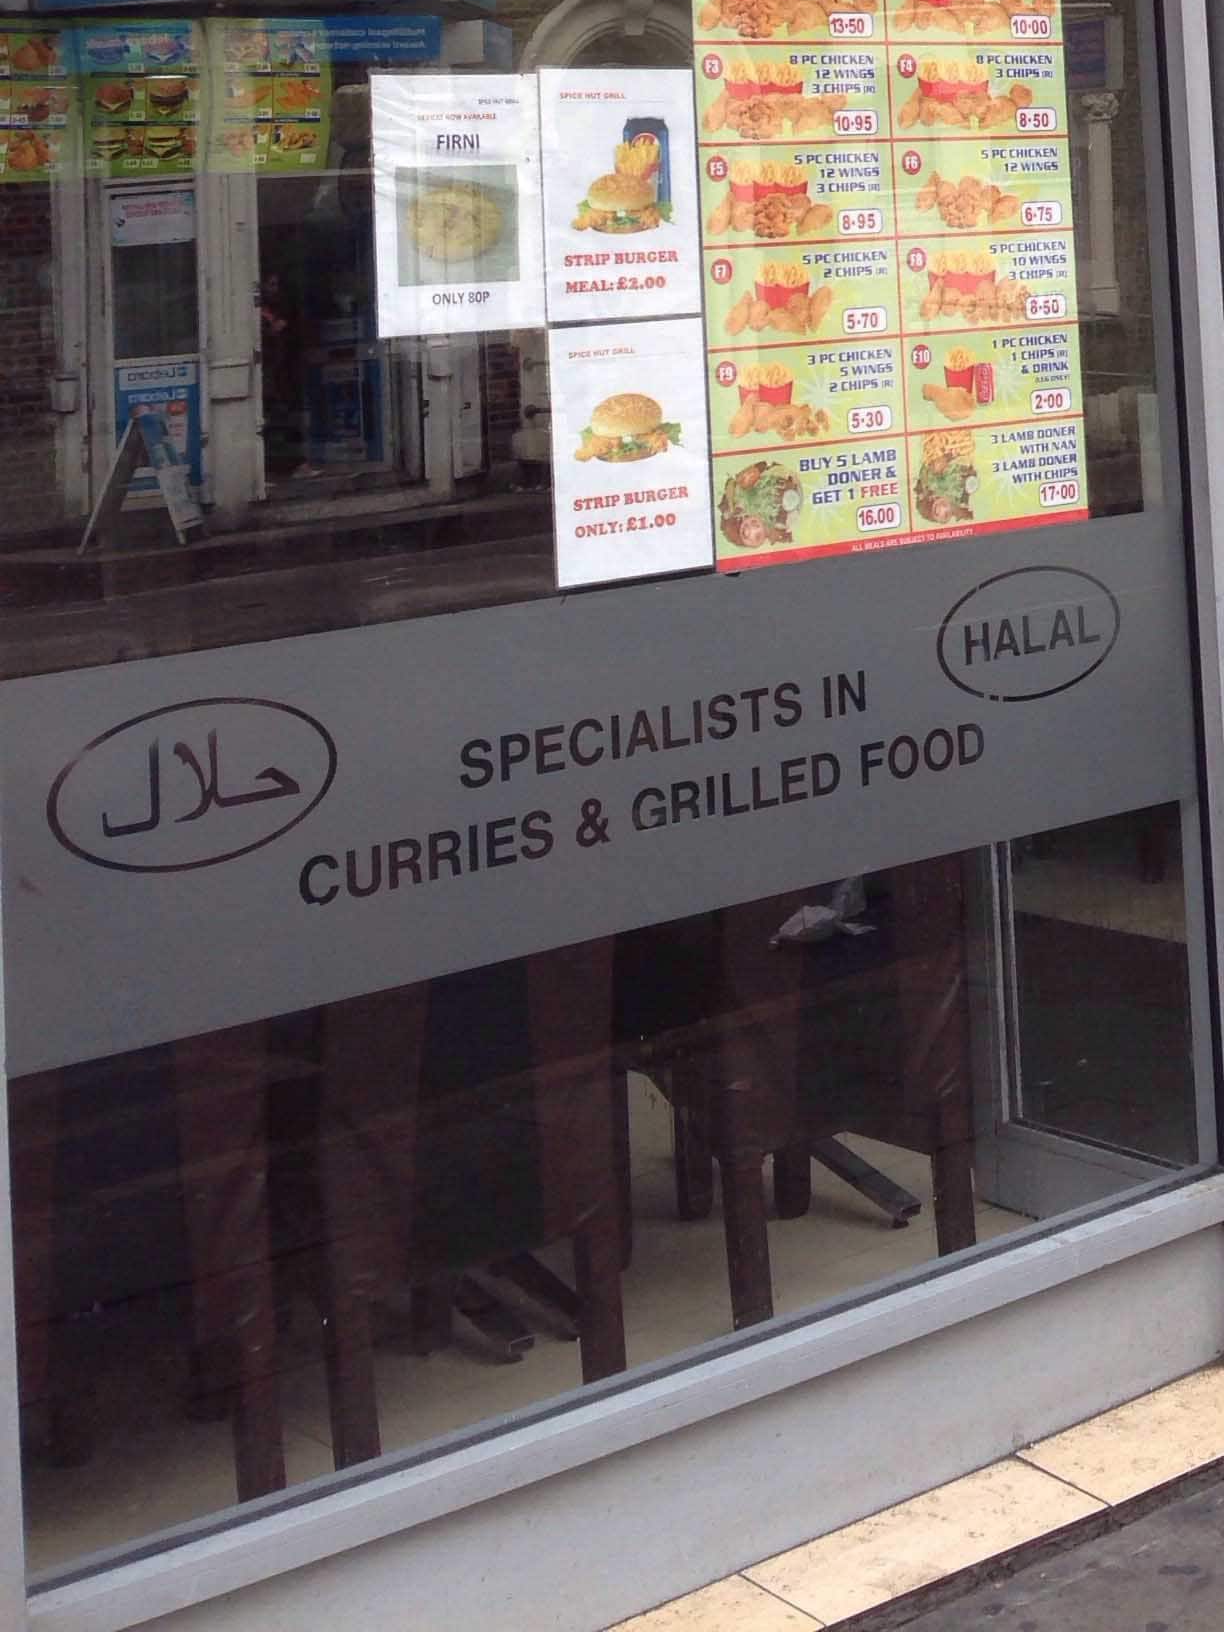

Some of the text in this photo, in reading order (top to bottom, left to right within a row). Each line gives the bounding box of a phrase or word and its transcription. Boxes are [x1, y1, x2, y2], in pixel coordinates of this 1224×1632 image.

[790, 55, 874, 66] 8 PC CHICKEN
[976, 54, 1053, 65] 8 PC CHICKEN
[815, 69, 875, 79] 12 WINGS
[996, 68, 1040, 79] 3 CHIPS
[559, 92, 582, 100] SPICE
[584, 92, 600, 100] HUT
[812, 84, 860, 94] 3 CHIPS
[436, 133, 480, 151] FIRNI
[794, 152, 879, 165] 5 PC CHICKEN
[981, 147, 1058, 159] 5 PC CHICKEN
[820, 167, 880, 178] 12 WINGS
[1004, 161, 1059, 172] 12 WINGS
[817, 181, 866, 193] 3 CHIPS
[989, 241, 1066, 254] 5 PC CHICKEN
[564, 250, 679, 267] STRIP BURGER
[803, 251, 887, 264] 5 PC CHICKEN
[1012, 254, 1067, 266] 10 WINGS
[824, 266, 873, 278] 2 CHIPS
[1010, 269, 1053, 281] 3 CHIPS
[566, 276, 665, 294] MEAL: £2.00
[432, 291, 490, 305] ONLY 80P
[992, 333, 1068, 349] 1 PC CHICKEN
[808, 349, 892, 365] 3 PC CHICKEN
[1012, 349, 1055, 361] 1 CHIPS
[840, 363, 893, 377] 5 WINGS
[1021, 361, 1069, 374] & DRINK
[829, 379, 879, 392] 2 CHIPS
[992, 426, 1076, 445] 3 LAMB DONER
[1020, 439, 1077, 454] WITH NAN
[800, 450, 896, 473] BUY 5 LAMB
[992, 453, 1077, 473] 3 LAMB DONER
[828, 466, 896, 486] DONER &
[1012, 467, 1078, 483] WITH CHIPS
[573, 486, 689, 511] STRIP BURGER
[812, 481, 899, 505] GET 1 FREE
[858, 507, 895, 525] 16.00
[574, 513, 676, 539] ONLY: £1.00
[963, 604, 1101, 666] HALAL
[460, 670, 867, 790] SPECIALISTS IN
[101, 727, 301, 839] حلال
[299, 722, 985, 906] CURRIES & GRILLED FOOD
